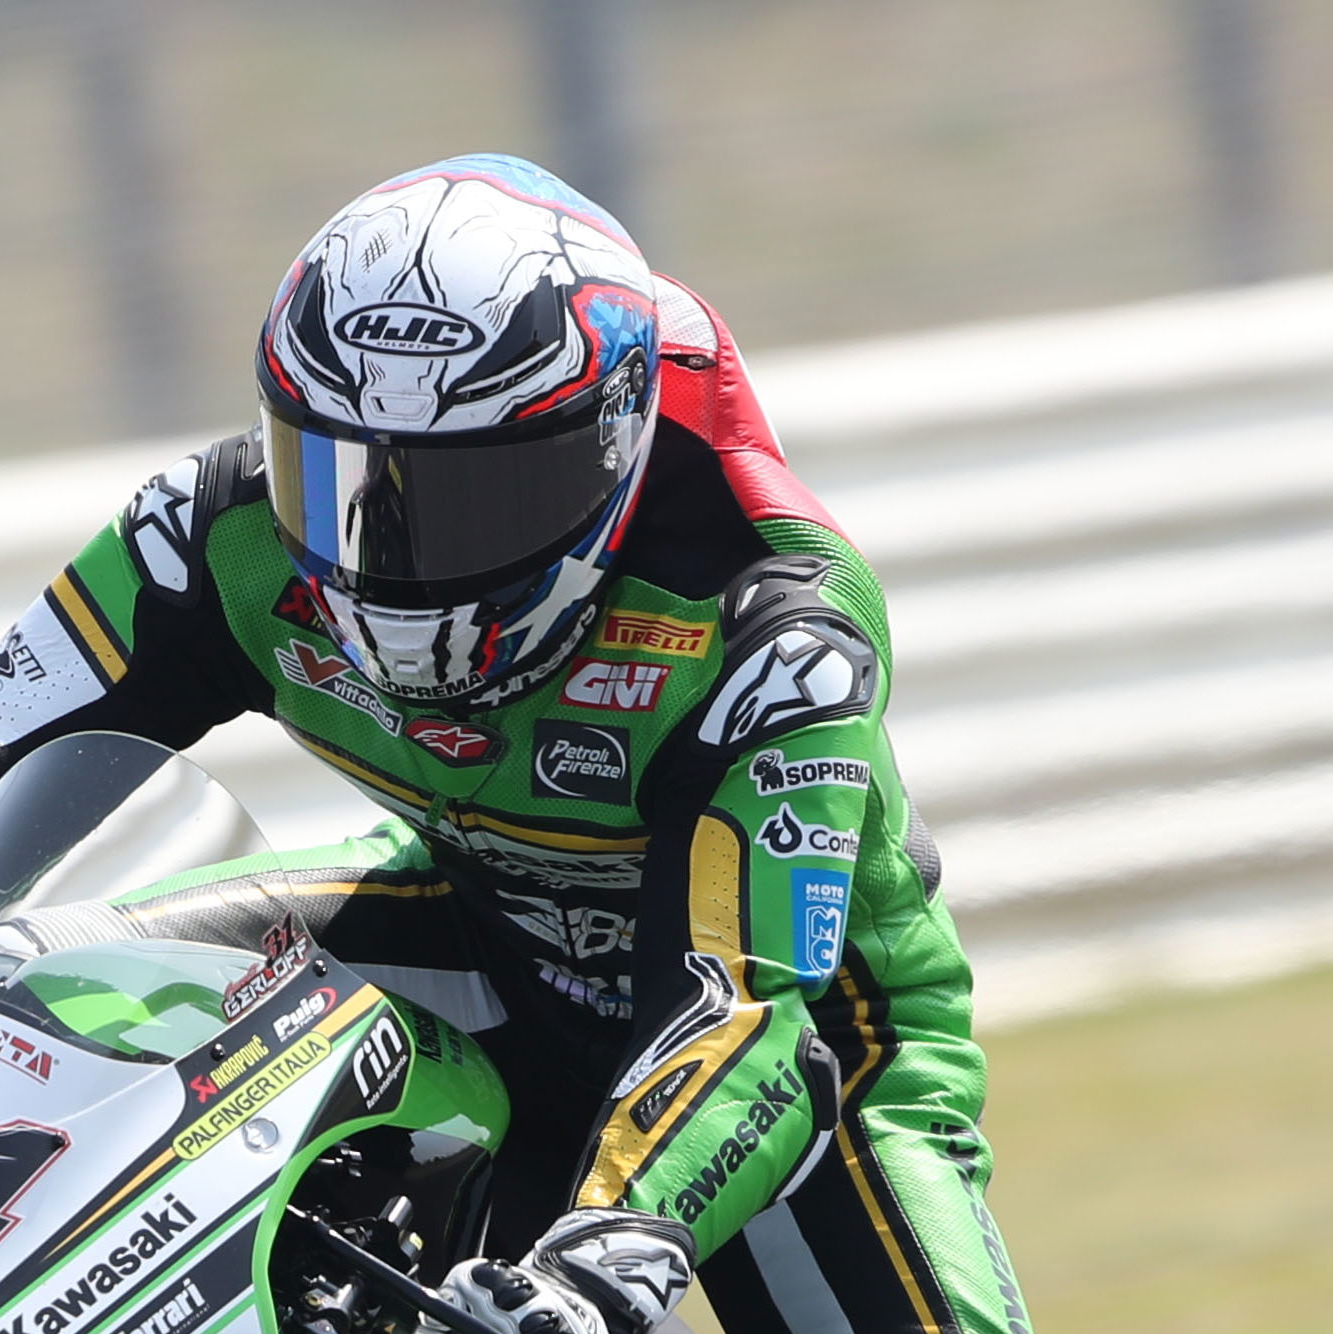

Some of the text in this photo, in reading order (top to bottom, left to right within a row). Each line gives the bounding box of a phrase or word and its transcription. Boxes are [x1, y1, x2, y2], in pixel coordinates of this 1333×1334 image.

[350, 315, 466, 347] HJC
[604, 615, 705, 651] PIRELLI
[377, 671, 483, 698] SOPREMA
[565, 663, 663, 708] GIVI
[548, 739, 610, 763] Petroli
[550, 760, 621, 779] Firenze
[806, 883, 845, 899] MOTO
[224, 937, 308, 1018] GERLOFF
[273, 991, 327, 1039] Puig
[353, 1016, 403, 1098] rin
[178, 1039, 326, 1156] PALFINGER ITALIA
